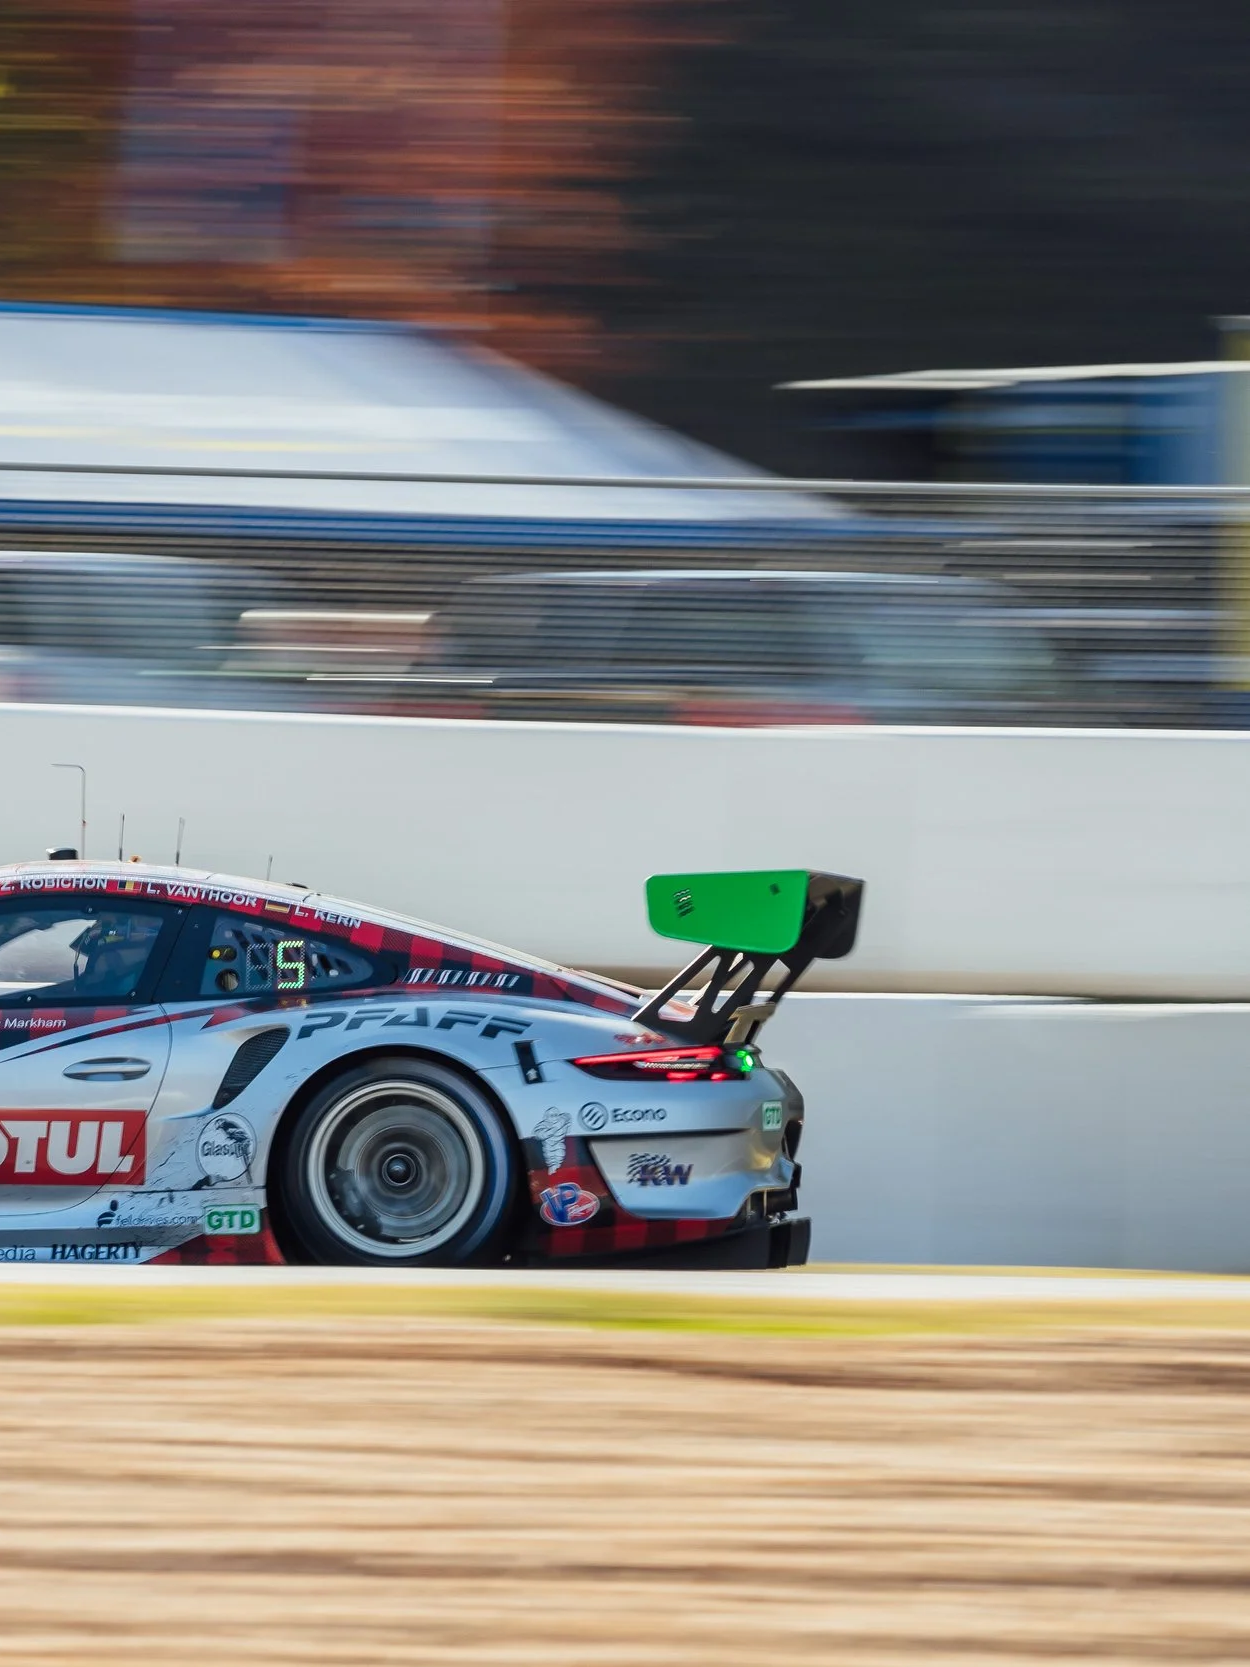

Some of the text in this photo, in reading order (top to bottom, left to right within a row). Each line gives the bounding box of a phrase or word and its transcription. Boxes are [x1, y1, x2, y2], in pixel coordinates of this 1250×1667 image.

[0, 878, 108, 891] Z. ROBICHON
[146, 882, 258, 907] L. VANTHOOR
[294, 906, 362, 929] L. KERN
[4, 1017, 67, 1028] Markham
[296, 1006, 533, 1040] PFAFF
[612, 1108, 667, 1122] Econo
[201, 1140, 252, 1158] Glas
[637, 1163, 694, 1187] KW
[207, 1210, 255, 1230] GTD
[51, 1241, 143, 1260] HAGERTY
